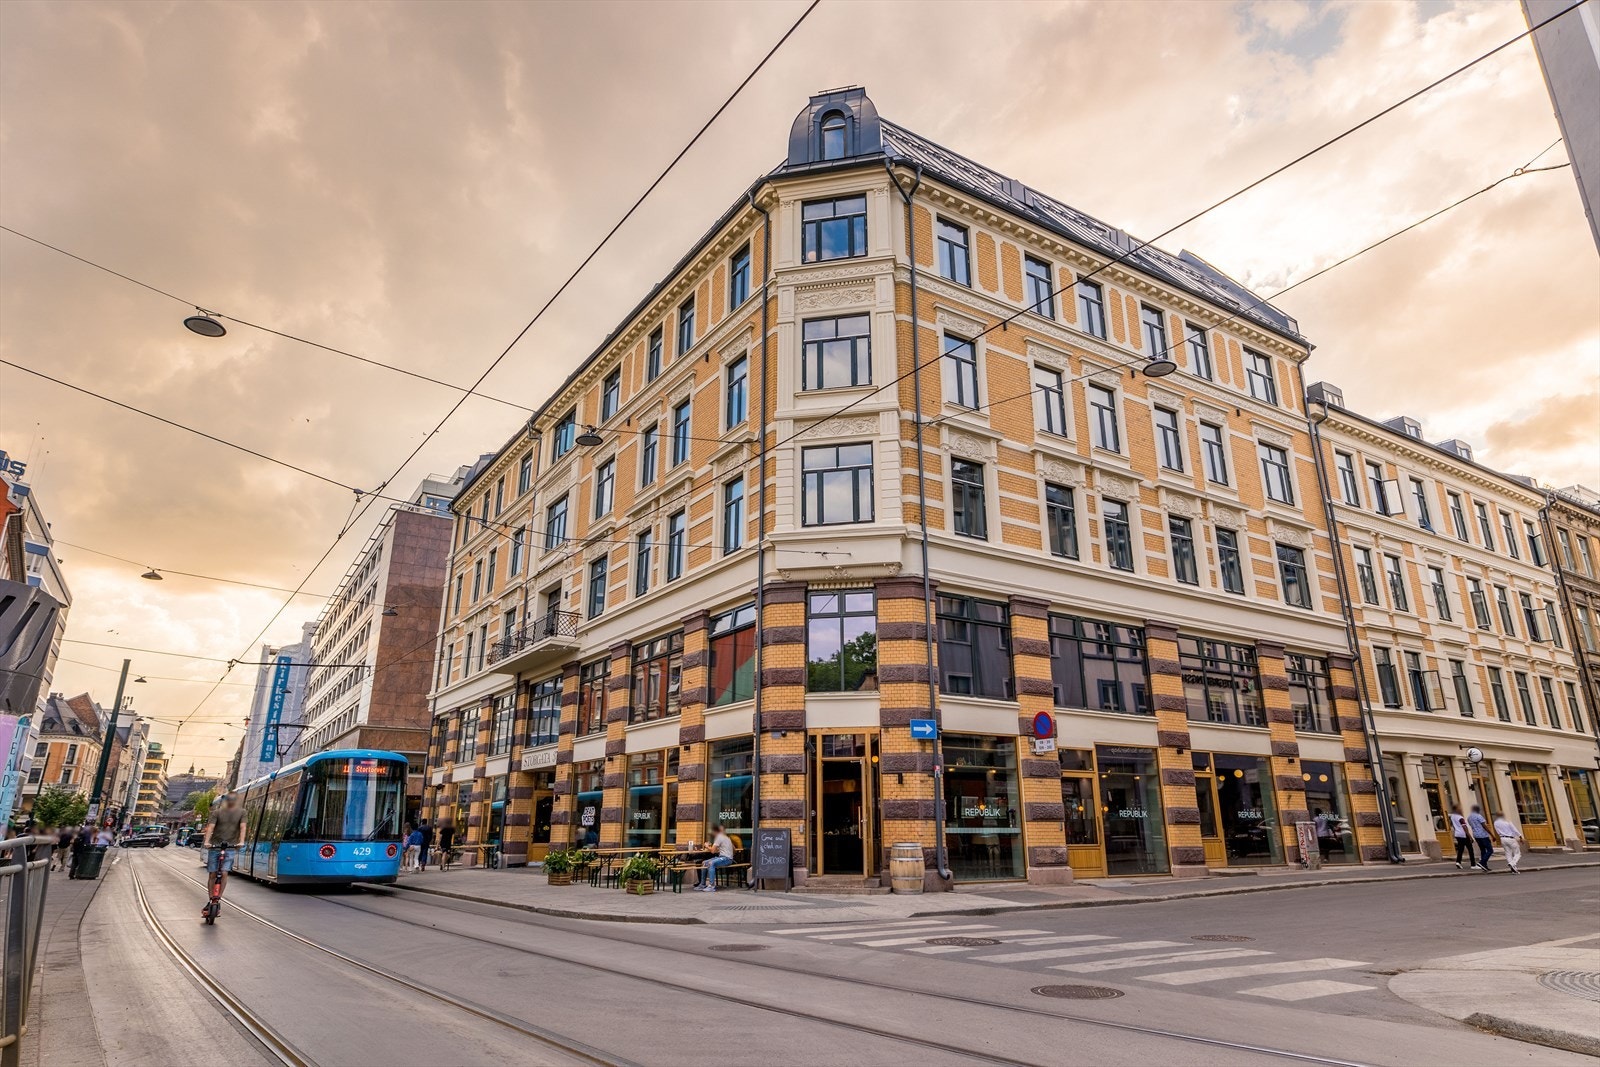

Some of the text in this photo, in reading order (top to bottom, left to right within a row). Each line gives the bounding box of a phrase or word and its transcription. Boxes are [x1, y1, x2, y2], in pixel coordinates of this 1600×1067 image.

[633, 812, 651, 820] REPUBLIK
[719, 811, 743, 820] REPUBLIK
[965, 808, 1001, 817] REPUBLIK
[1119, 809, 1148, 818] REPUBLIK
[1237, 811, 1263, 819] REPUBLIK
[1318, 813, 1340, 821] REPUBLIK
[353, 847, 371, 856] 429
